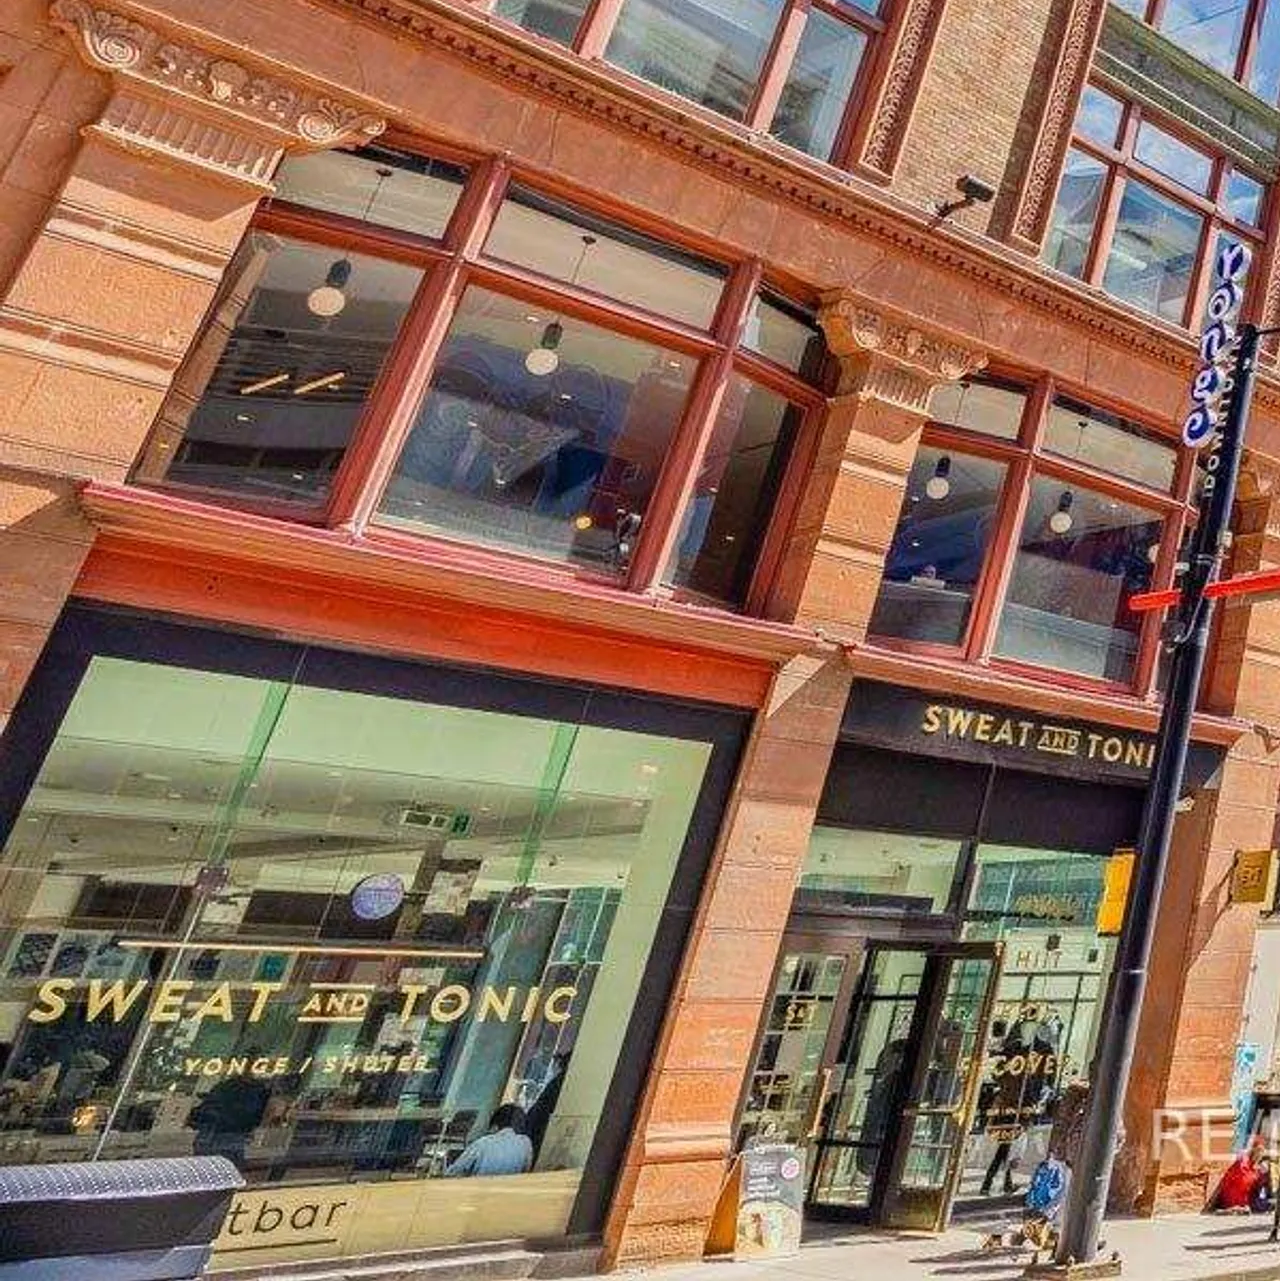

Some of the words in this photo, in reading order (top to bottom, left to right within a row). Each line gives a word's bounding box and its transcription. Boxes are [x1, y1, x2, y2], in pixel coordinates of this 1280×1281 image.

[922, 704, 1034, 748] SWEAT
[1038, 729, 1080, 752] AND
[1087, 734, 1156, 769] TONI
[27, 978, 283, 1022] SWEAT
[302, 992, 370, 1014] AND
[399, 984, 578, 1022] TONIC
[183, 1057, 291, 1076] YONGE
